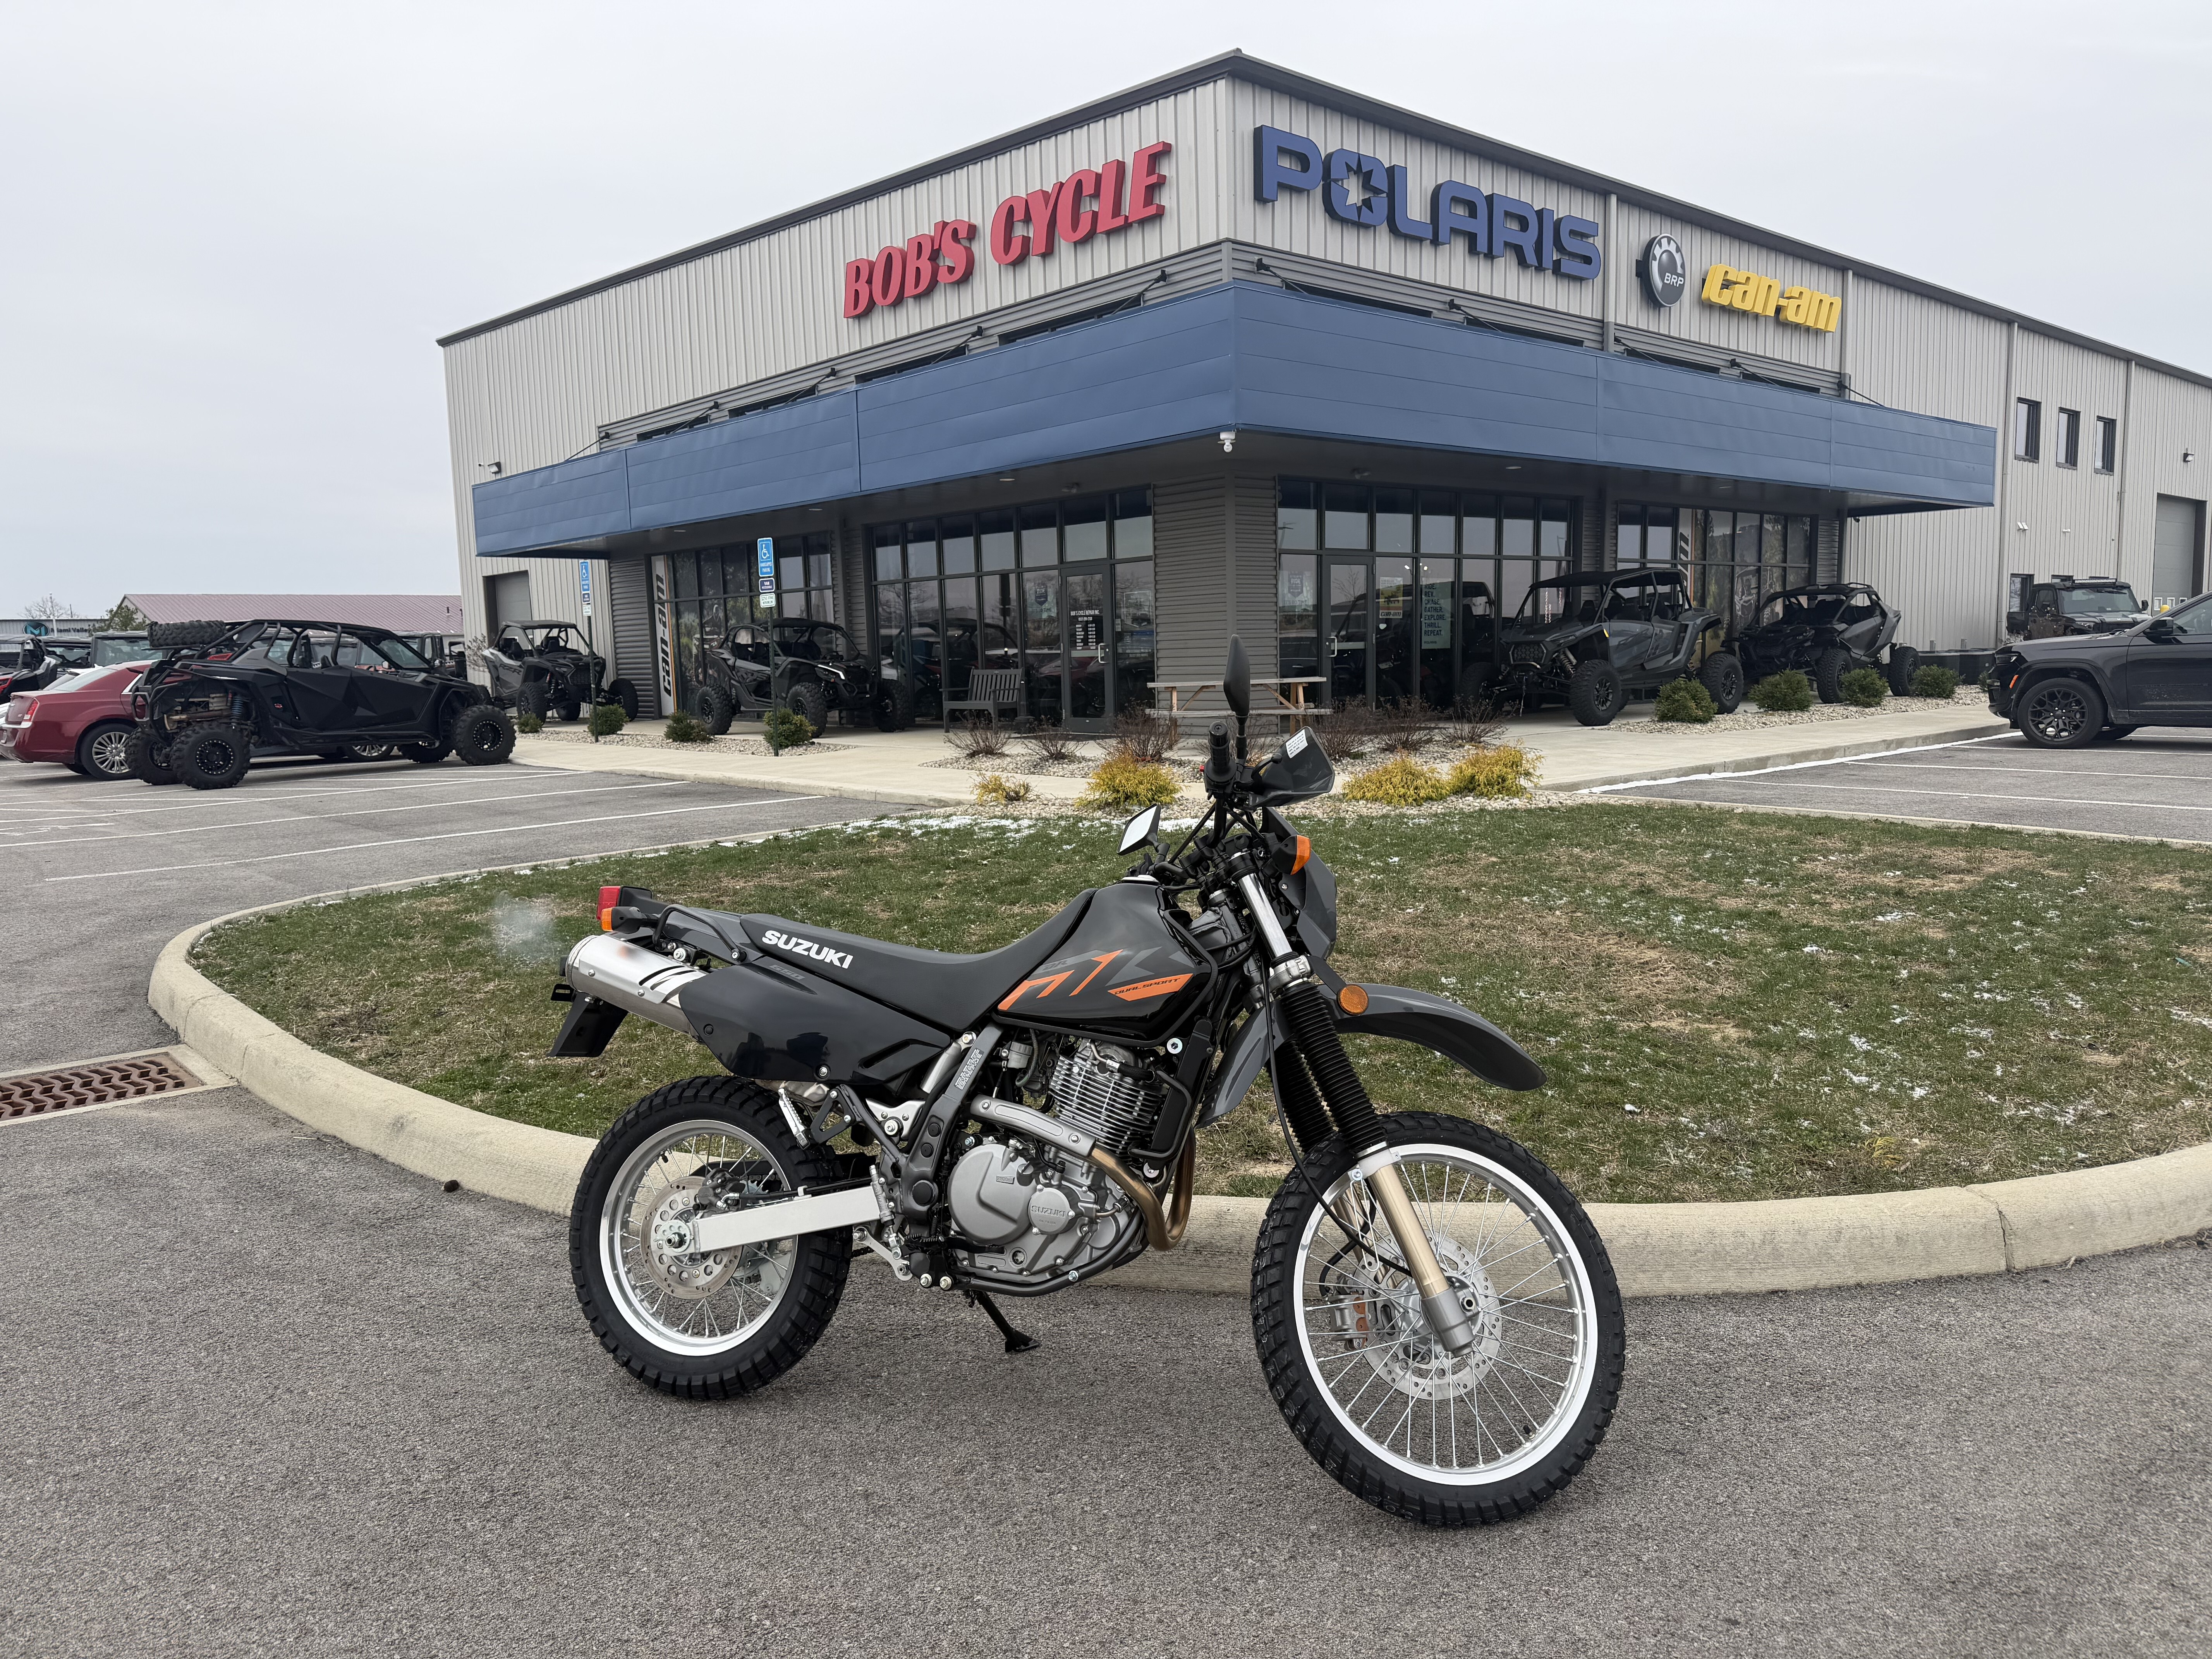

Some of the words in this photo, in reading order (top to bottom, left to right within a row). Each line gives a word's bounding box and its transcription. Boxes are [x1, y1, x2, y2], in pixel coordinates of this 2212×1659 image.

[1254, 124, 1601, 280] POLARIS
[843, 219, 976, 318] BOB'S
[990, 141, 1172, 266] CYCLE
[1664, 272, 1684, 287] BRP
[762, 930, 854, 969] SUZUKI
[1114, 986, 1141, 995] DUAL
[1142, 977, 1181, 988] SPORT
[1031, 1206, 1065, 1218] SUZUKI
